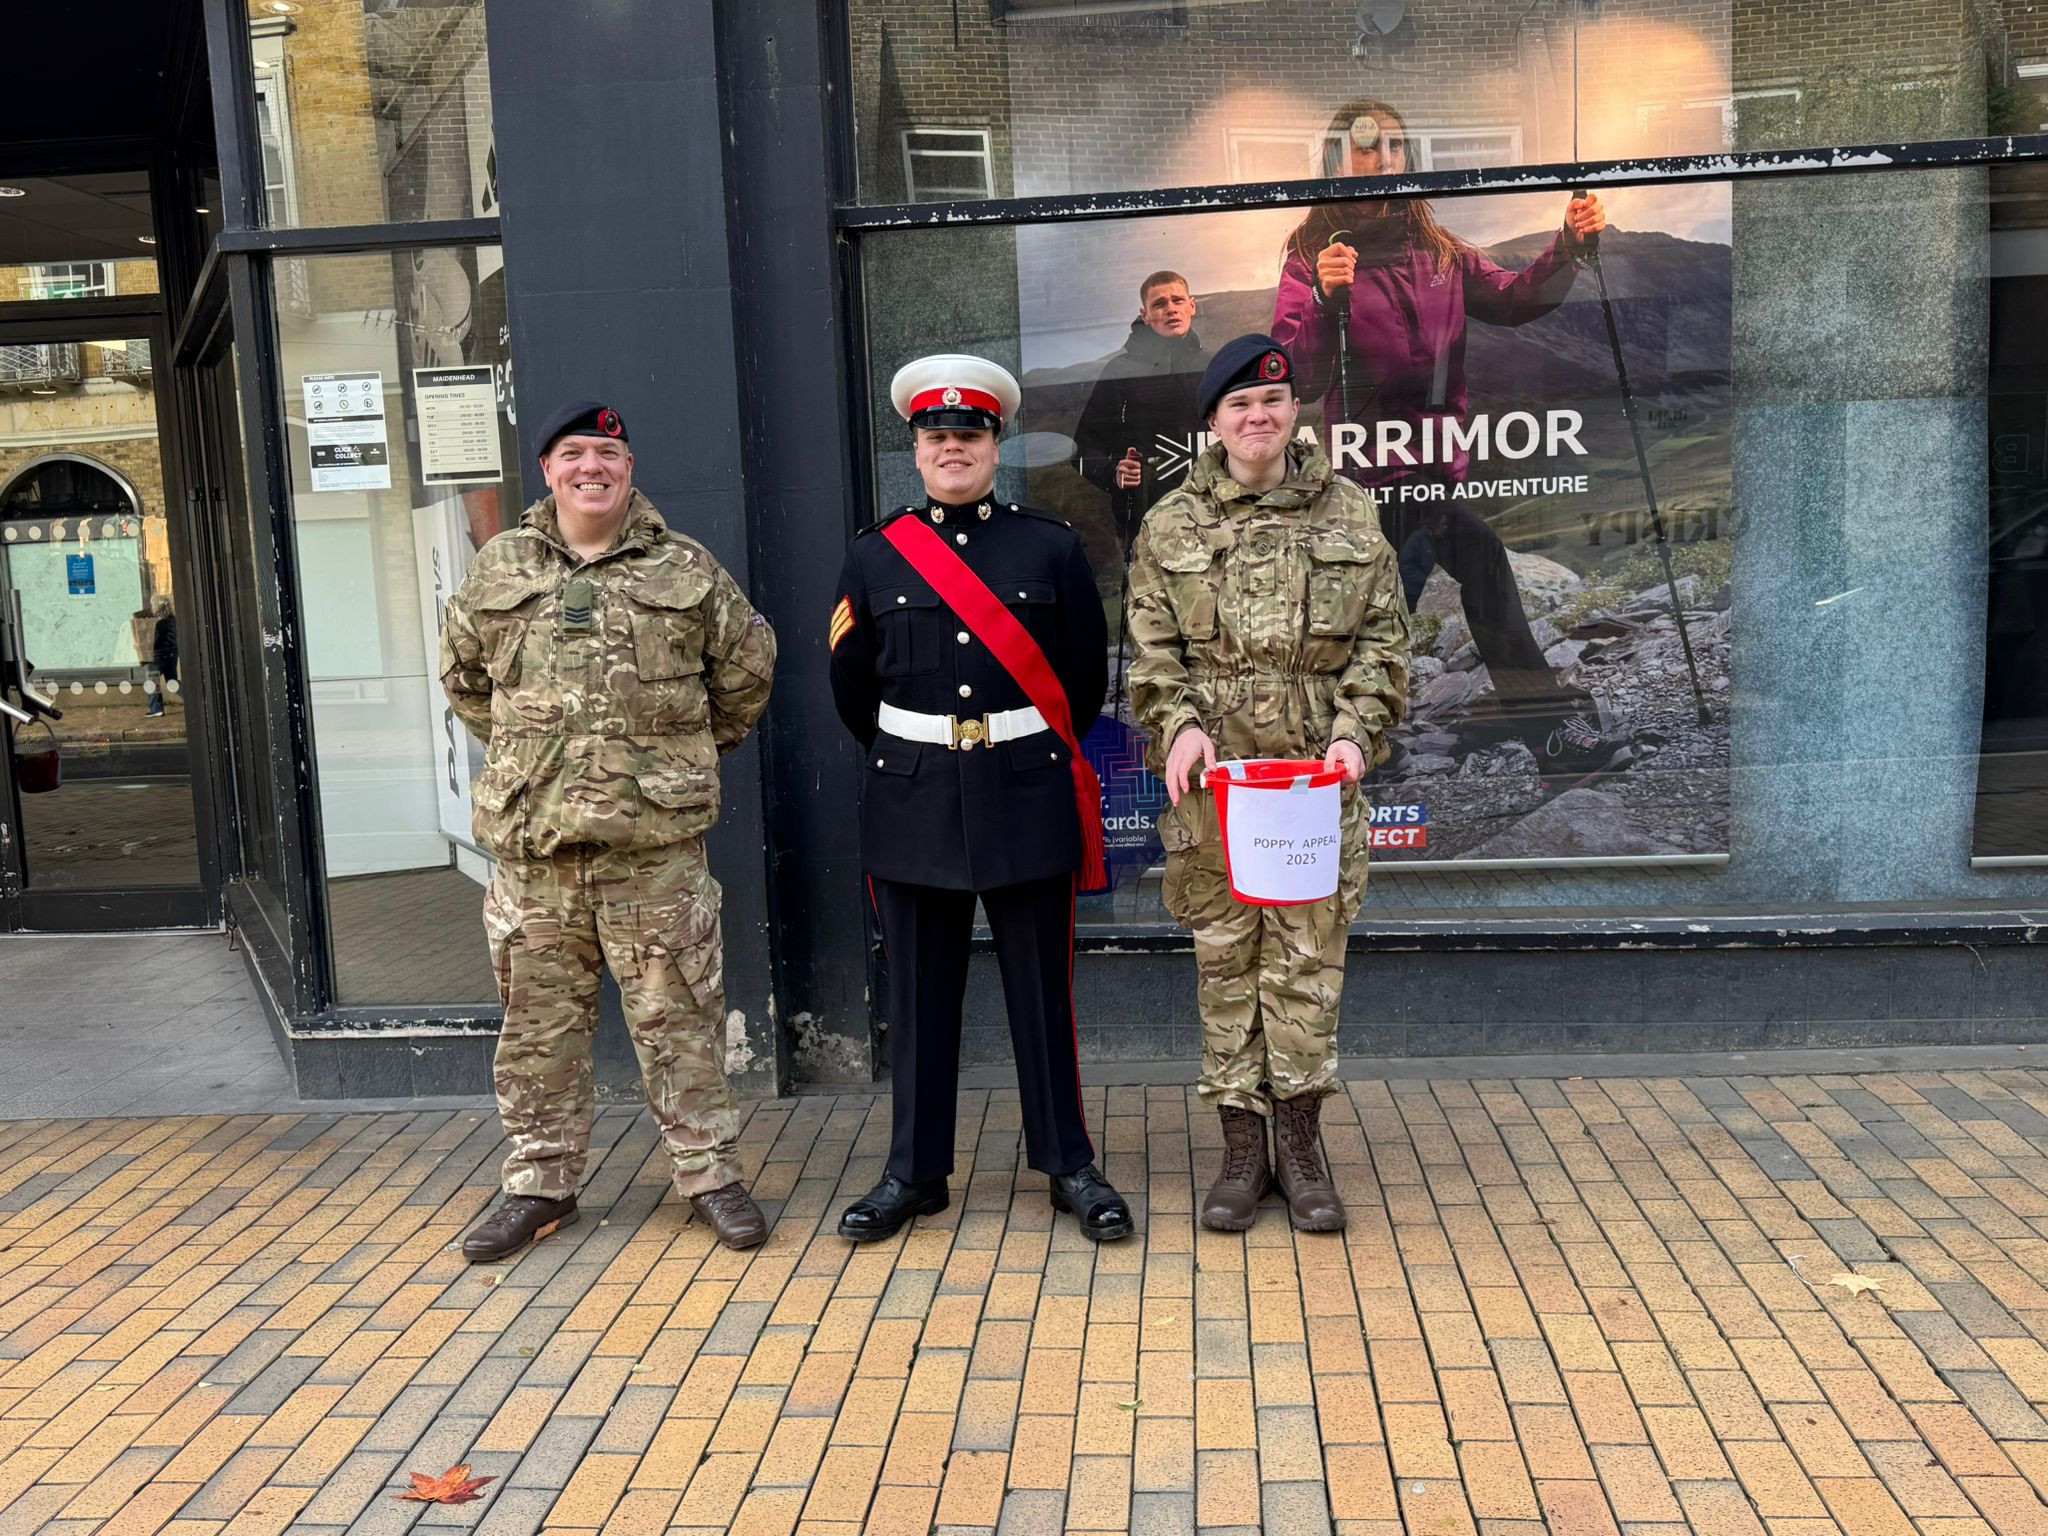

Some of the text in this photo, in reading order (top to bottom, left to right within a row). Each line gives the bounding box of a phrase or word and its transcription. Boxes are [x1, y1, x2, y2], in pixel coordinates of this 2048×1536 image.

[432, 374, 475, 382] MAIDENHEAD
[334, 452, 362, 460] COLLECT
[1400, 483, 1446, 503] FOR
[1451, 475, 1588, 500] ADVENTURE
[1101, 810, 1156, 831] ards.
[1254, 834, 1337, 849] POPPY APPEAL
[1286, 853, 1317, 865] 2025
